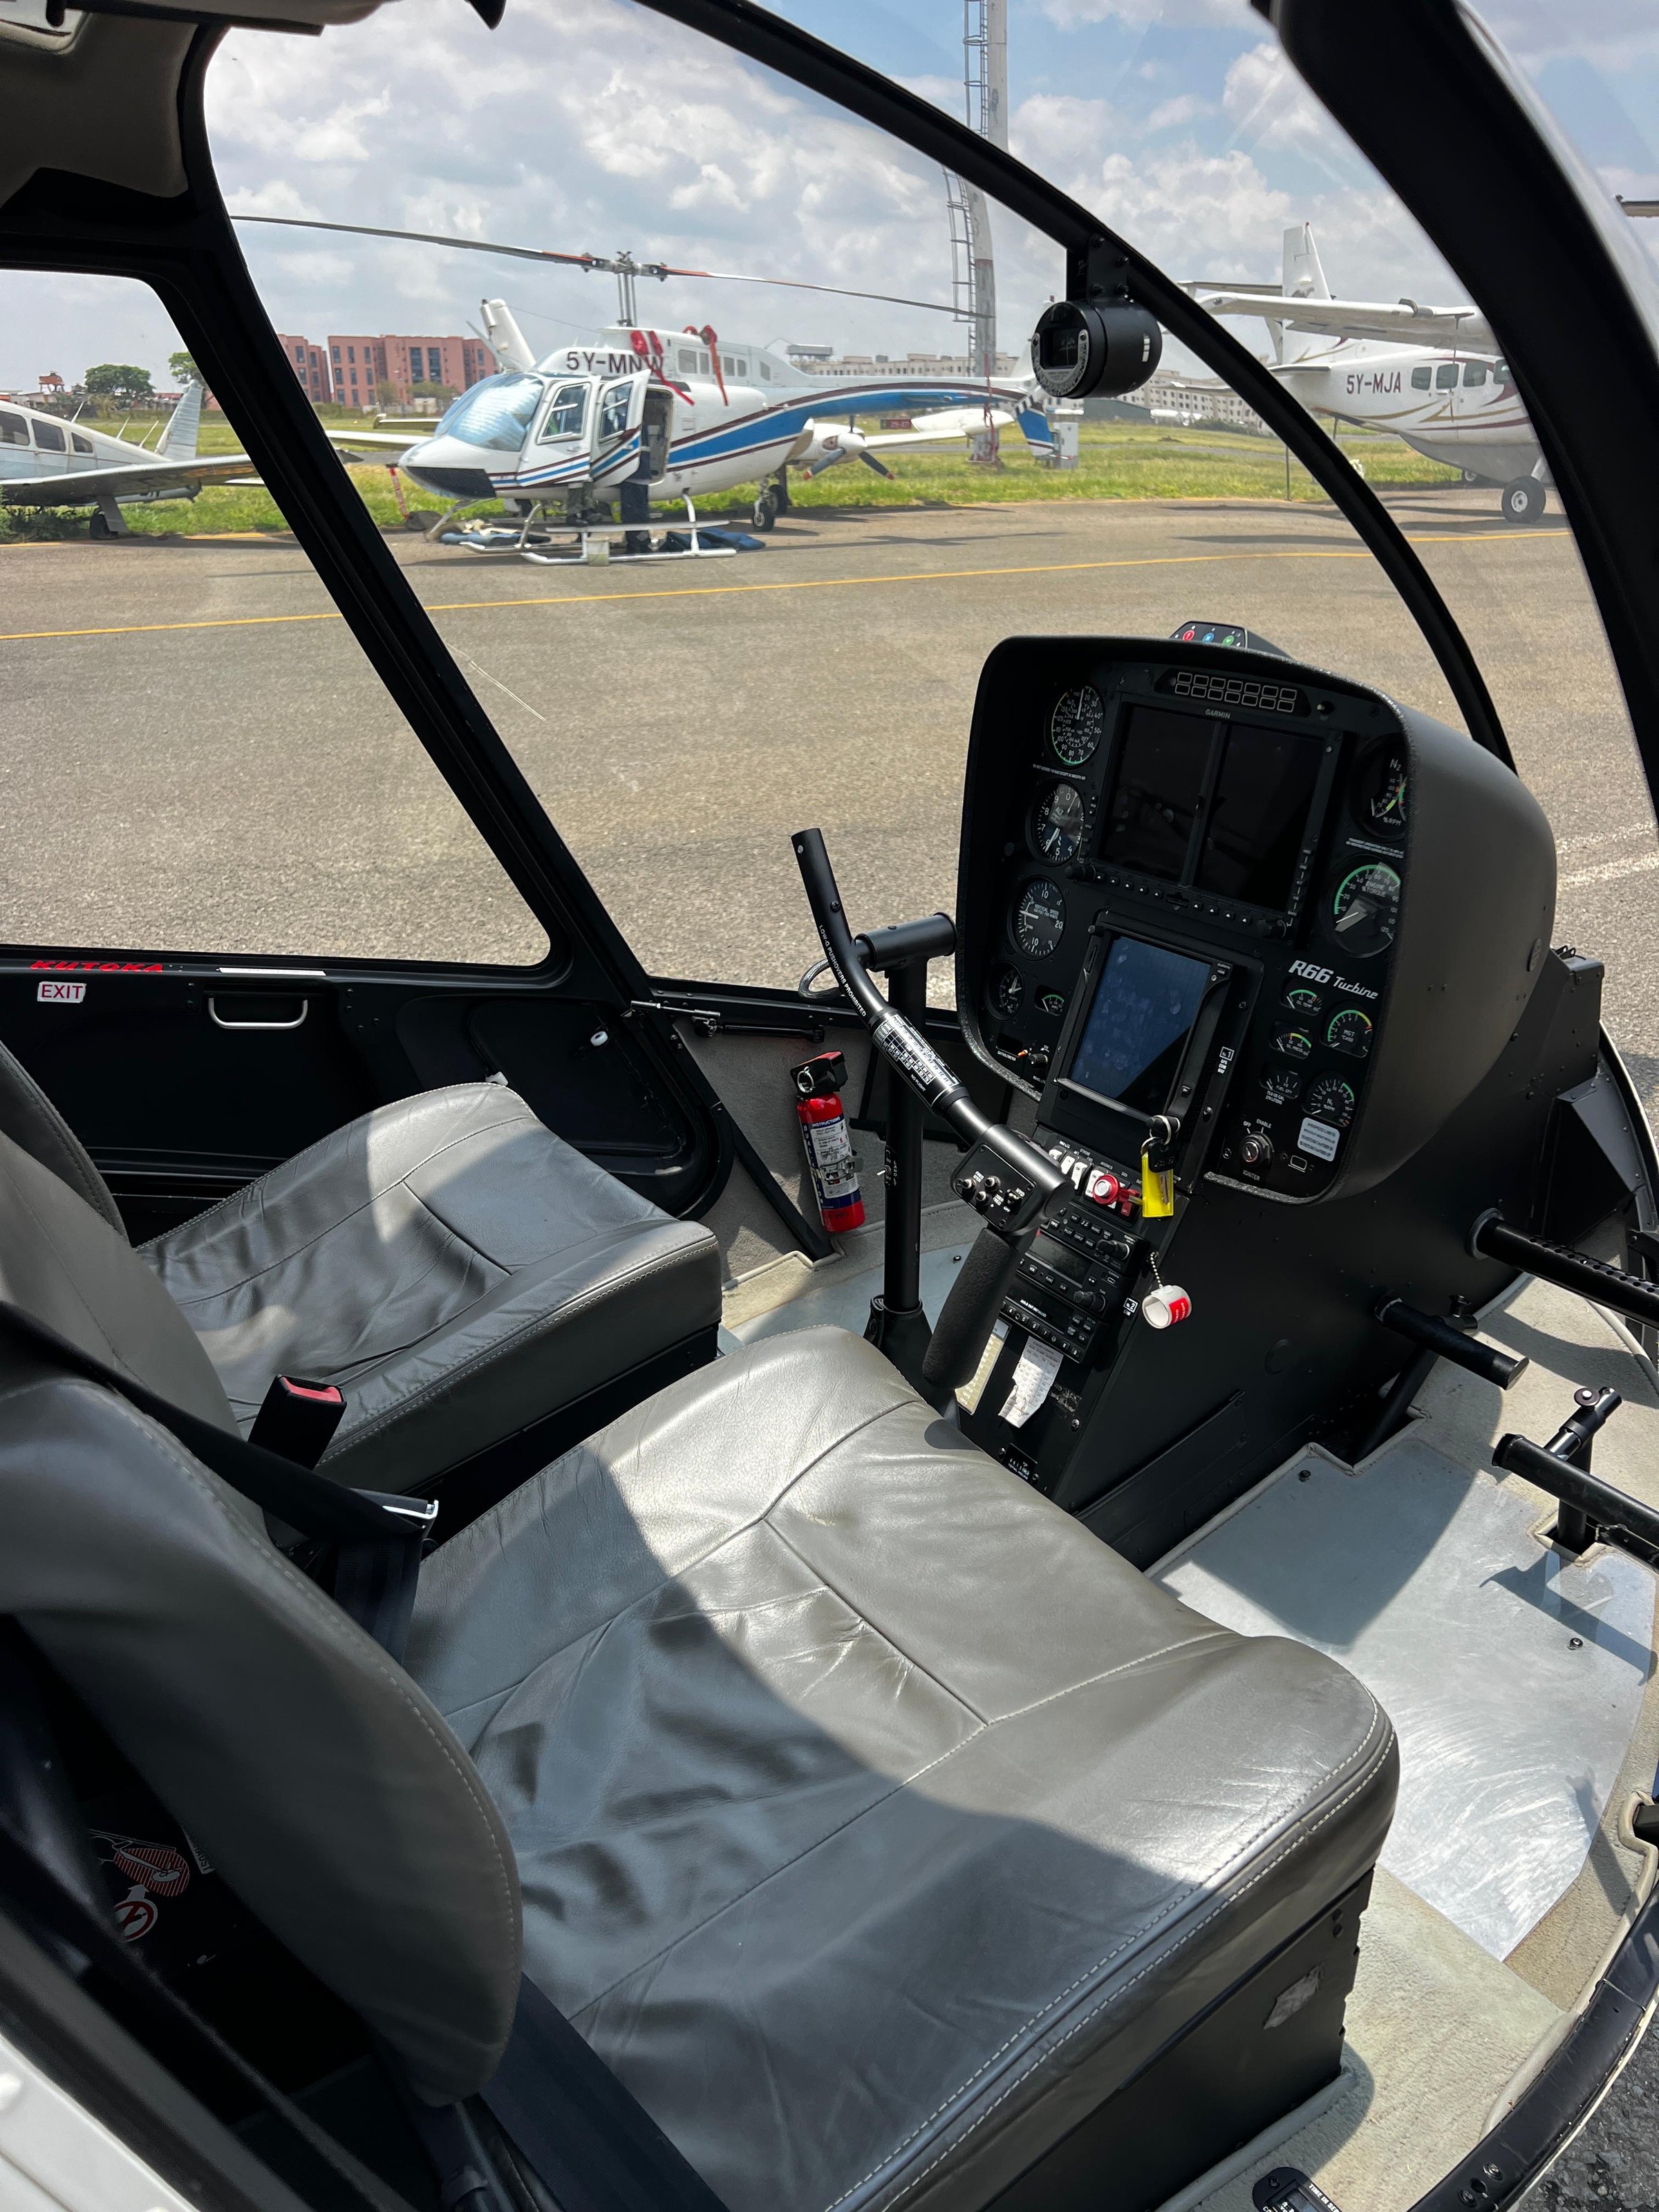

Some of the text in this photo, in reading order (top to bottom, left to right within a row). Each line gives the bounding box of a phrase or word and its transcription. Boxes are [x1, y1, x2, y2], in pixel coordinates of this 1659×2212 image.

[1347, 371, 1400, 394] 5Y-MJA
[1205, 709, 1231, 720] GARMIN
[1044, 807, 1049, 816] 8
[1055, 847, 1060, 856] 5
[1067, 845, 1073, 854] 4
[1365, 881, 1387, 890] ENGINE
[1041, 889, 1049, 899] 10
[1055, 920, 1063, 930] 20
[1031, 937, 1039, 946] 10
[30, 960, 163, 973] KUTOKA
[827, 946, 847, 984] PUSHOVERS
[844, 983, 867, 1018] PROHIBITED
[1288, 959, 1378, 1000] R66 Turbine
[41, 984, 84, 1000] EXIT
[915, 1079, 926, 1092] FLIGHT
[812, 1116, 841, 1127] INSTRUCTIONS
[1256, 1118, 1272, 1129] ENABLE
[1242, 1170, 1260, 1181] IGNITER
[1309, 2183, 1323, 2198] TIME
[1321, 2196, 1329, 2204] IN
